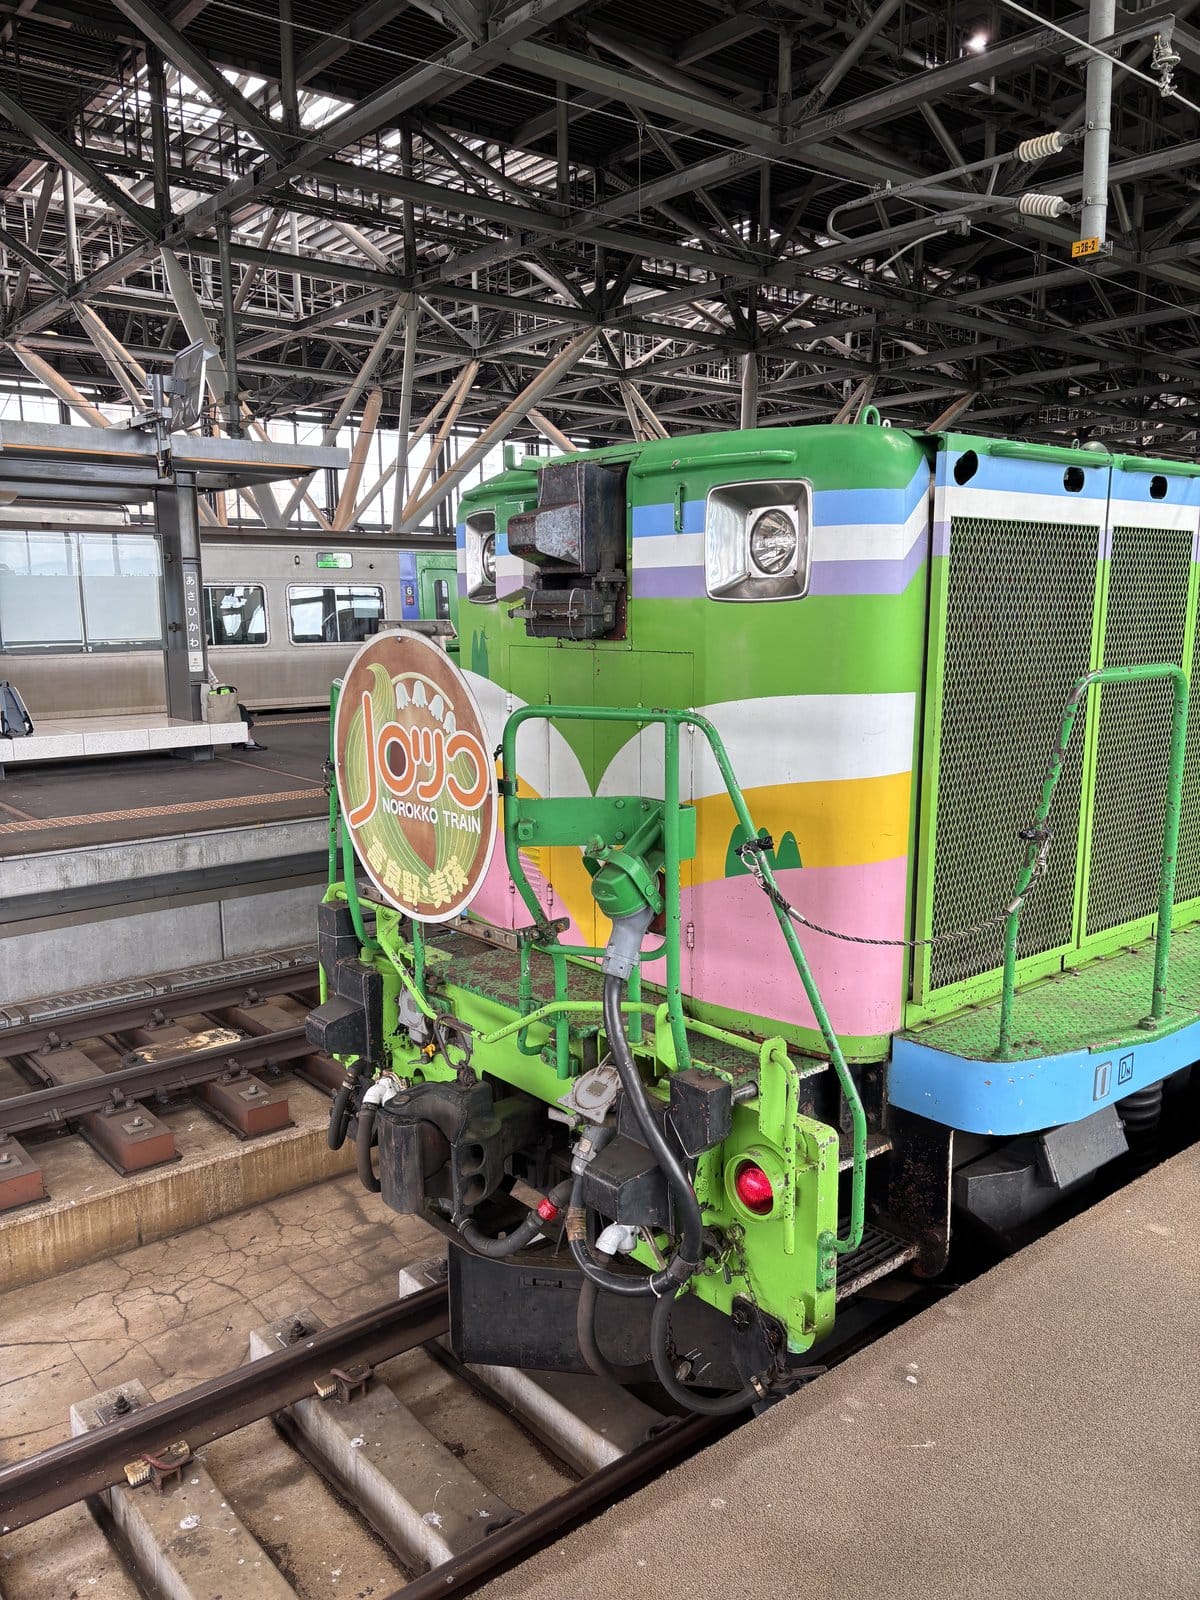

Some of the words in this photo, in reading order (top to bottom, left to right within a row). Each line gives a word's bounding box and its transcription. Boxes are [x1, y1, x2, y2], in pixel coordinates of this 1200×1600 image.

[406, 586, 413, 595] 6
[185, 576, 199, 648] あさひかわ
[382, 796, 438, 824] NOROKKO
[442, 810, 480, 834] TRAIN
